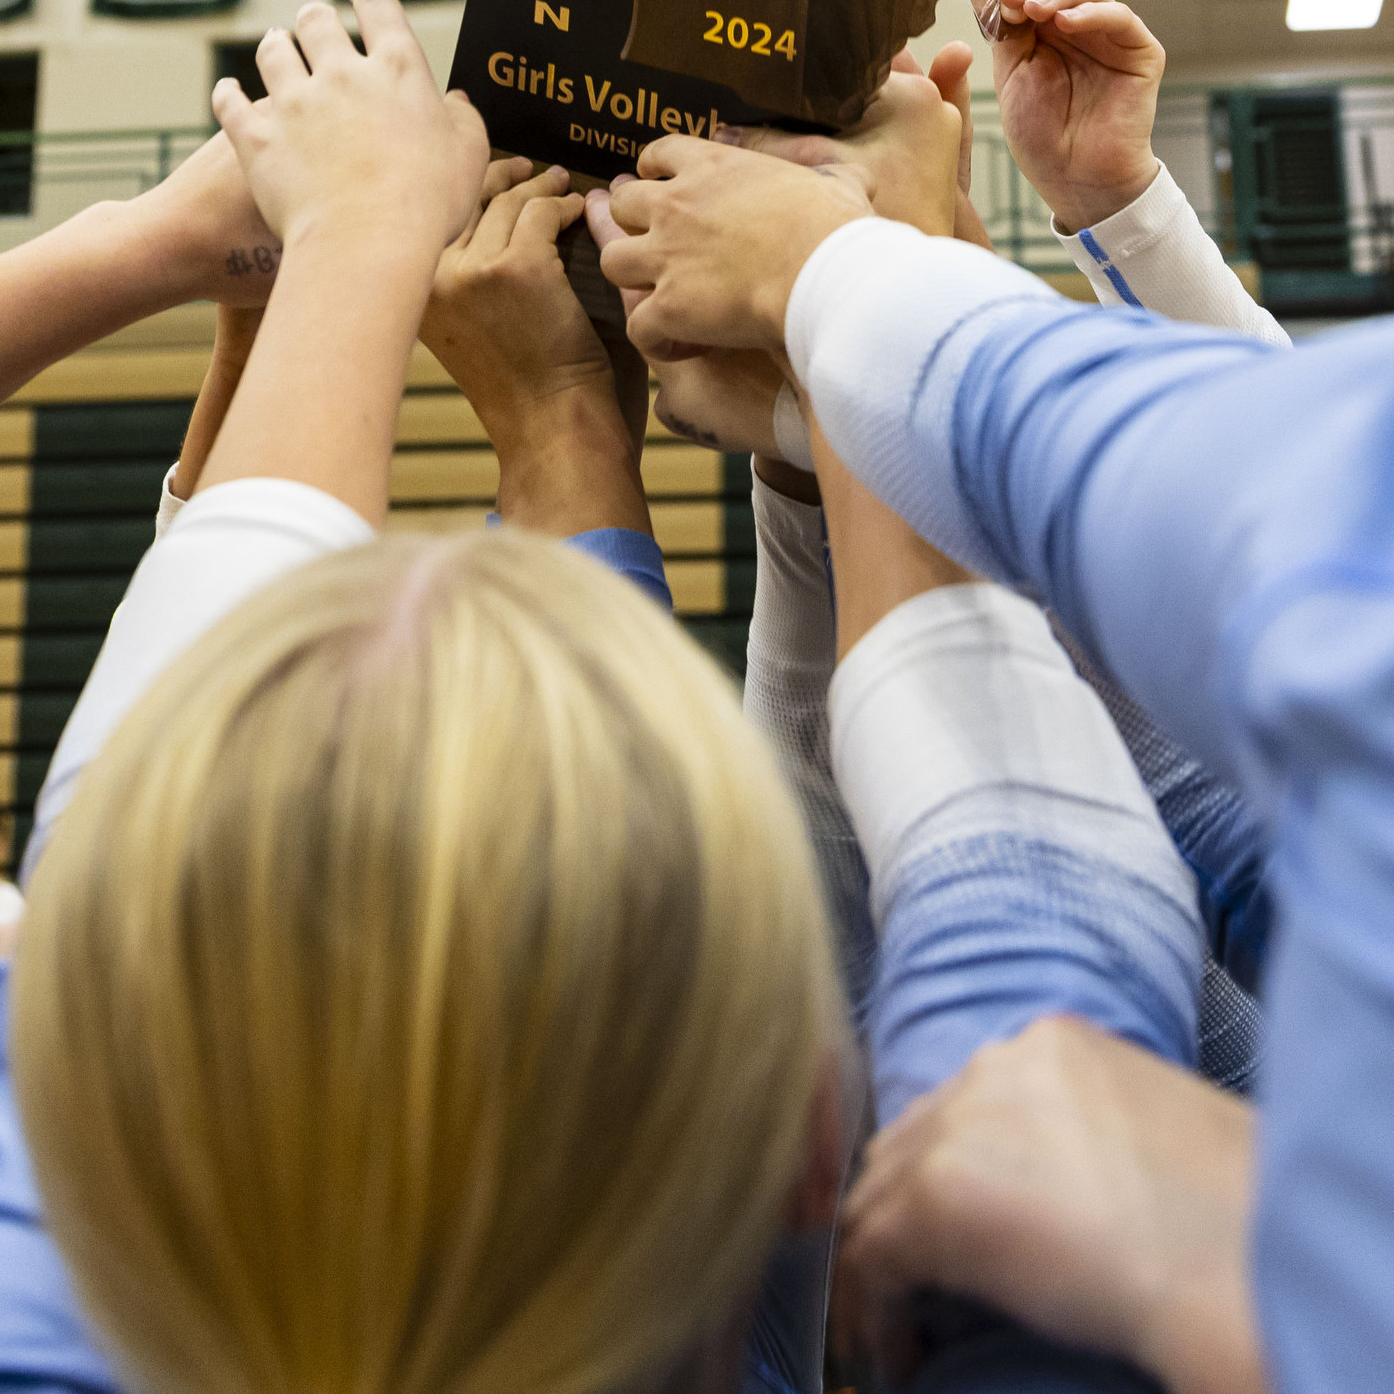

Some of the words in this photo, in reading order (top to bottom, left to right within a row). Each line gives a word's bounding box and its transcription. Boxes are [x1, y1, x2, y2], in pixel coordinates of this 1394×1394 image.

[702, 10, 798, 63] 2024
[487, 52, 575, 105] Girls
[568, 123, 647, 158] DIVISI
